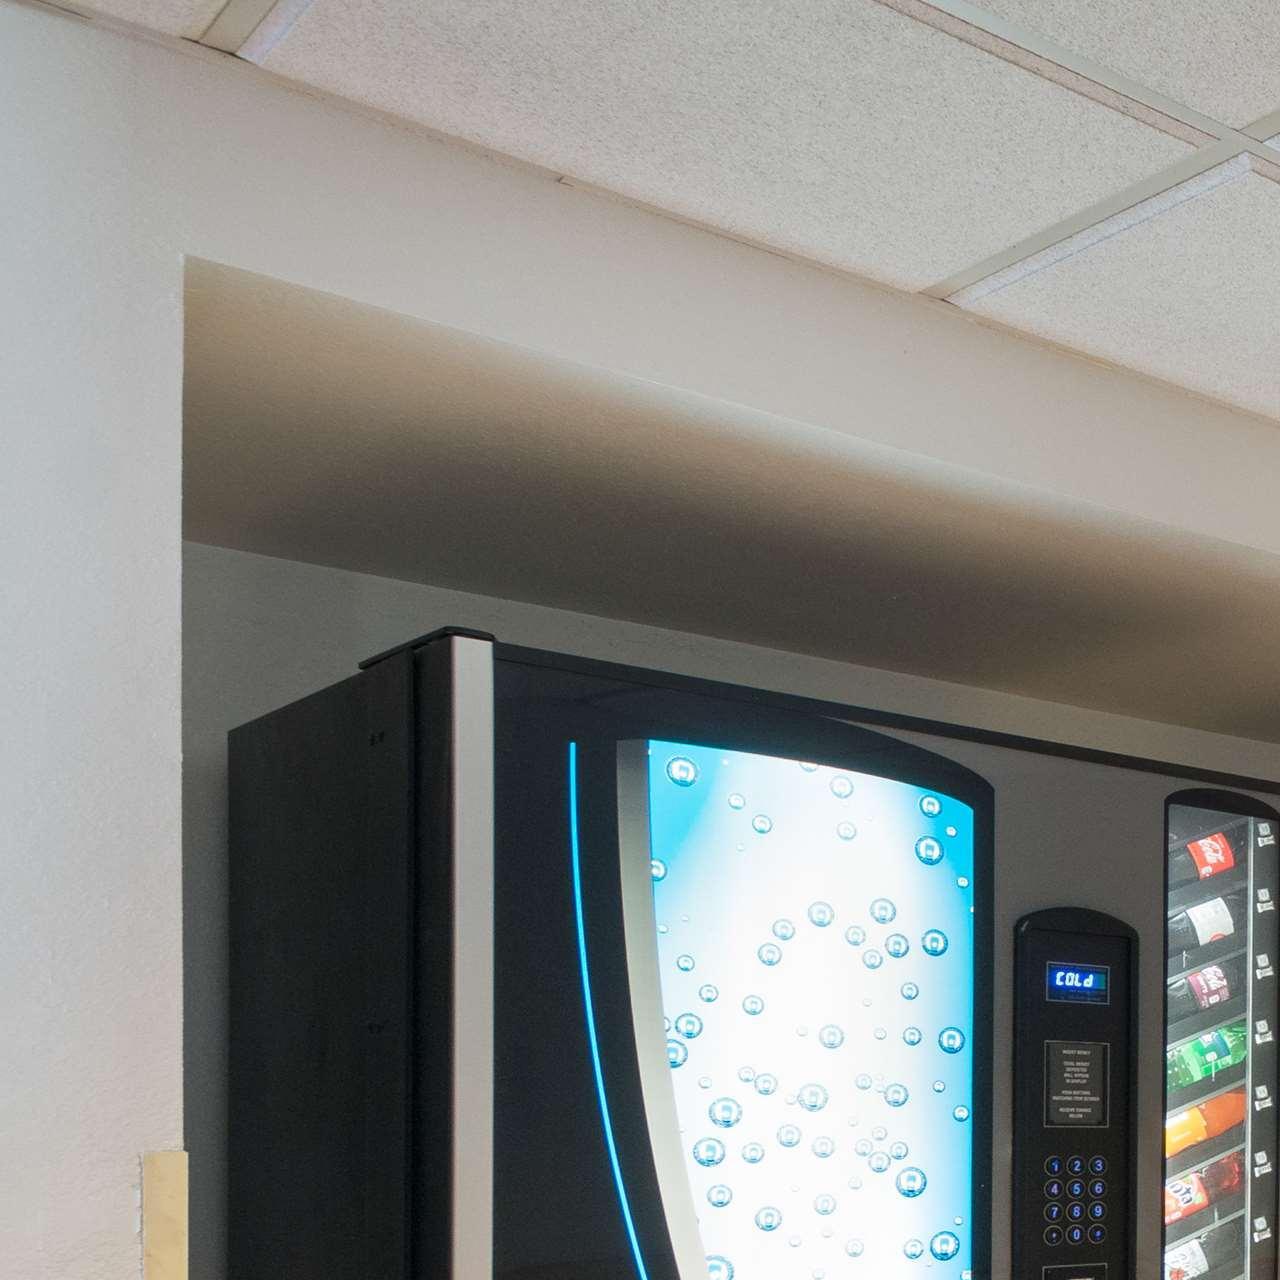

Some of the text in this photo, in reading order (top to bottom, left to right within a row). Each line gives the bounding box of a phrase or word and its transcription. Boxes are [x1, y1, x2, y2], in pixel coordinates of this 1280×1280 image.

[1052, 1160, 1103, 1171] 1 2 3
[1051, 1182, 1103, 1195] 4 5 6
[1051, 1205, 1102, 1218] 7 8 9
[1073, 1229, 1080, 1240] 0
